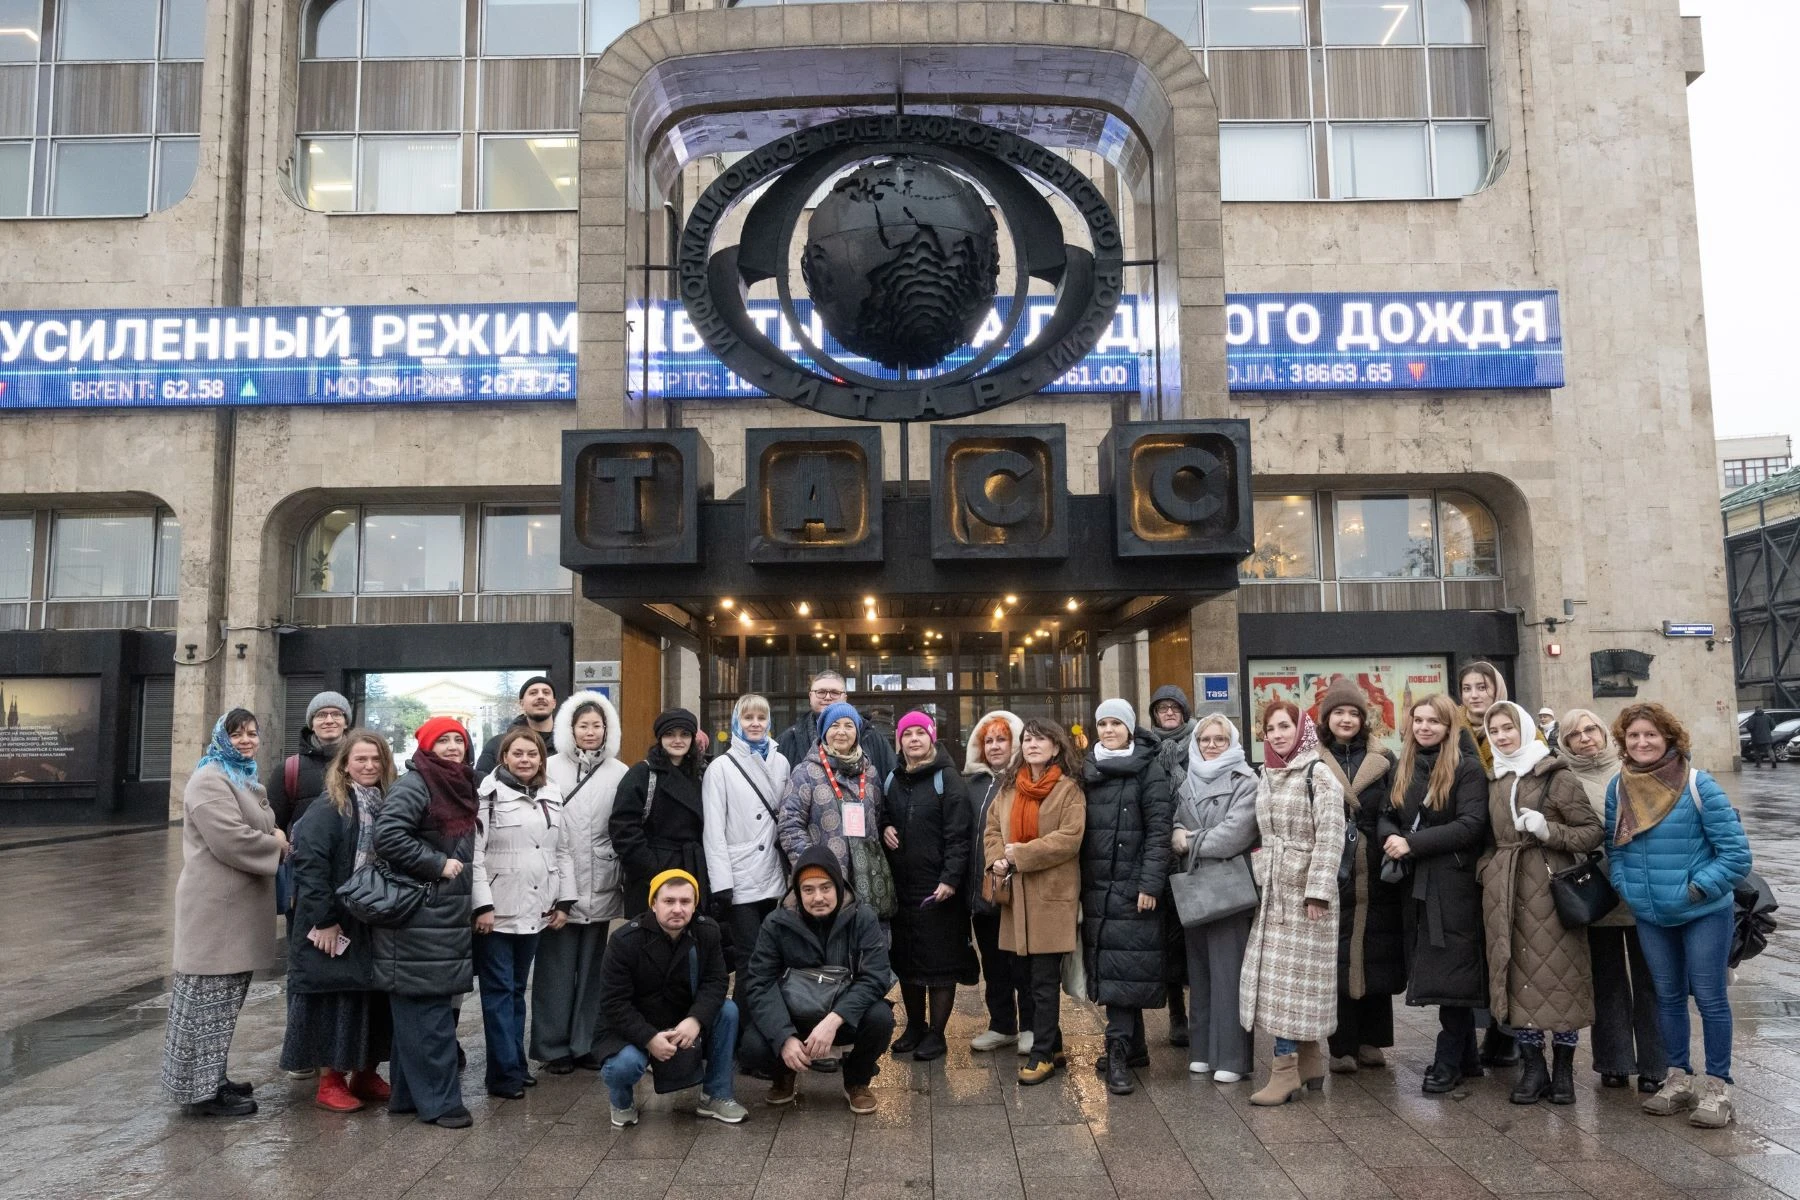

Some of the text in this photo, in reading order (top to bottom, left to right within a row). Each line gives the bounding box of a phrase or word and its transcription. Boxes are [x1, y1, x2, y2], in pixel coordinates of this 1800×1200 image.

[679, 115, 1119, 369] ИНФОРМАЦИОННОЕ ТЕЛЕГРАФНОЕ АГЕНТСТВО РОССИИ
[0, 307, 351, 362] УСИЛЕННЫЙ
[372, 311, 578, 358] РЕЖИМ
[1336, 300, 1547, 352] ДОЖДЯ
[71, 379, 225, 401] BRENT: 62.58
[1288, 362, 1393, 383] 38663.65
[595, 446, 1223, 536] ТАСС
[1407, 671, 1441, 684] ПОБЕДА!
